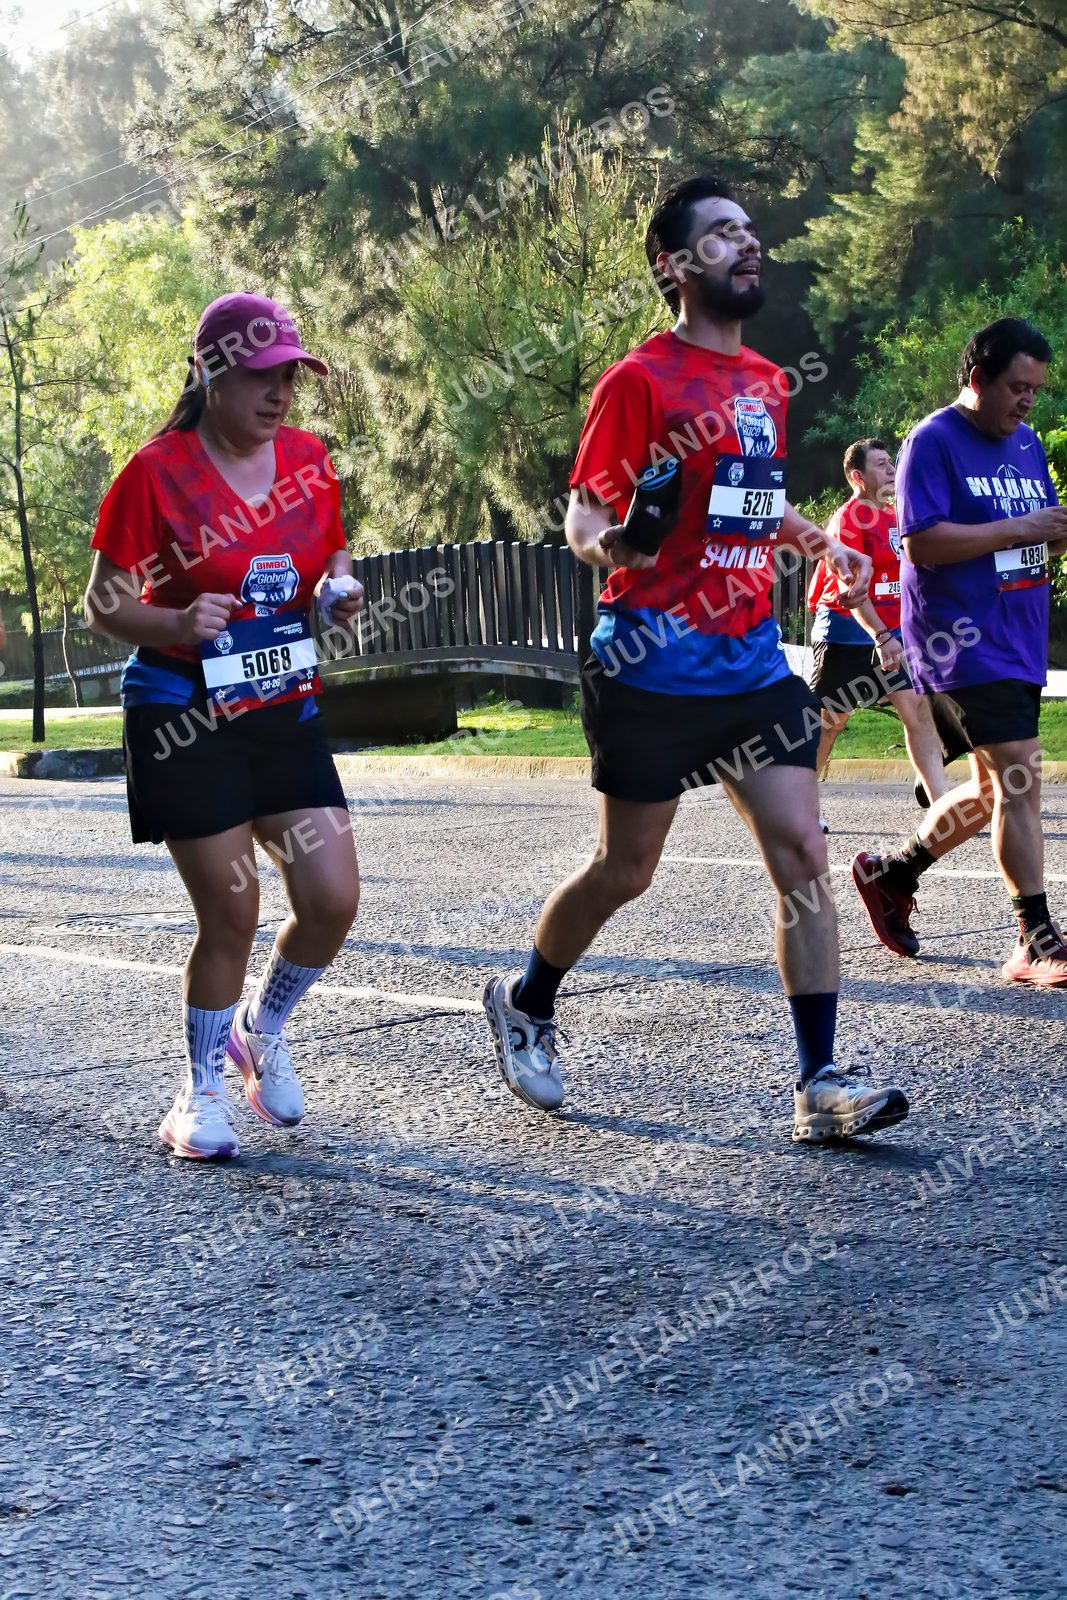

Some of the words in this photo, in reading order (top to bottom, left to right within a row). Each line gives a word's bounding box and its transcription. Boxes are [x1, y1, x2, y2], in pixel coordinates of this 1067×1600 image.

[742, 490, 774, 516] 5276
[256, 560, 287, 570] BIMBO
[257, 571, 287, 584] Global
[241, 646, 292, 679] 5068
[298, 682, 313, 692] 10K
